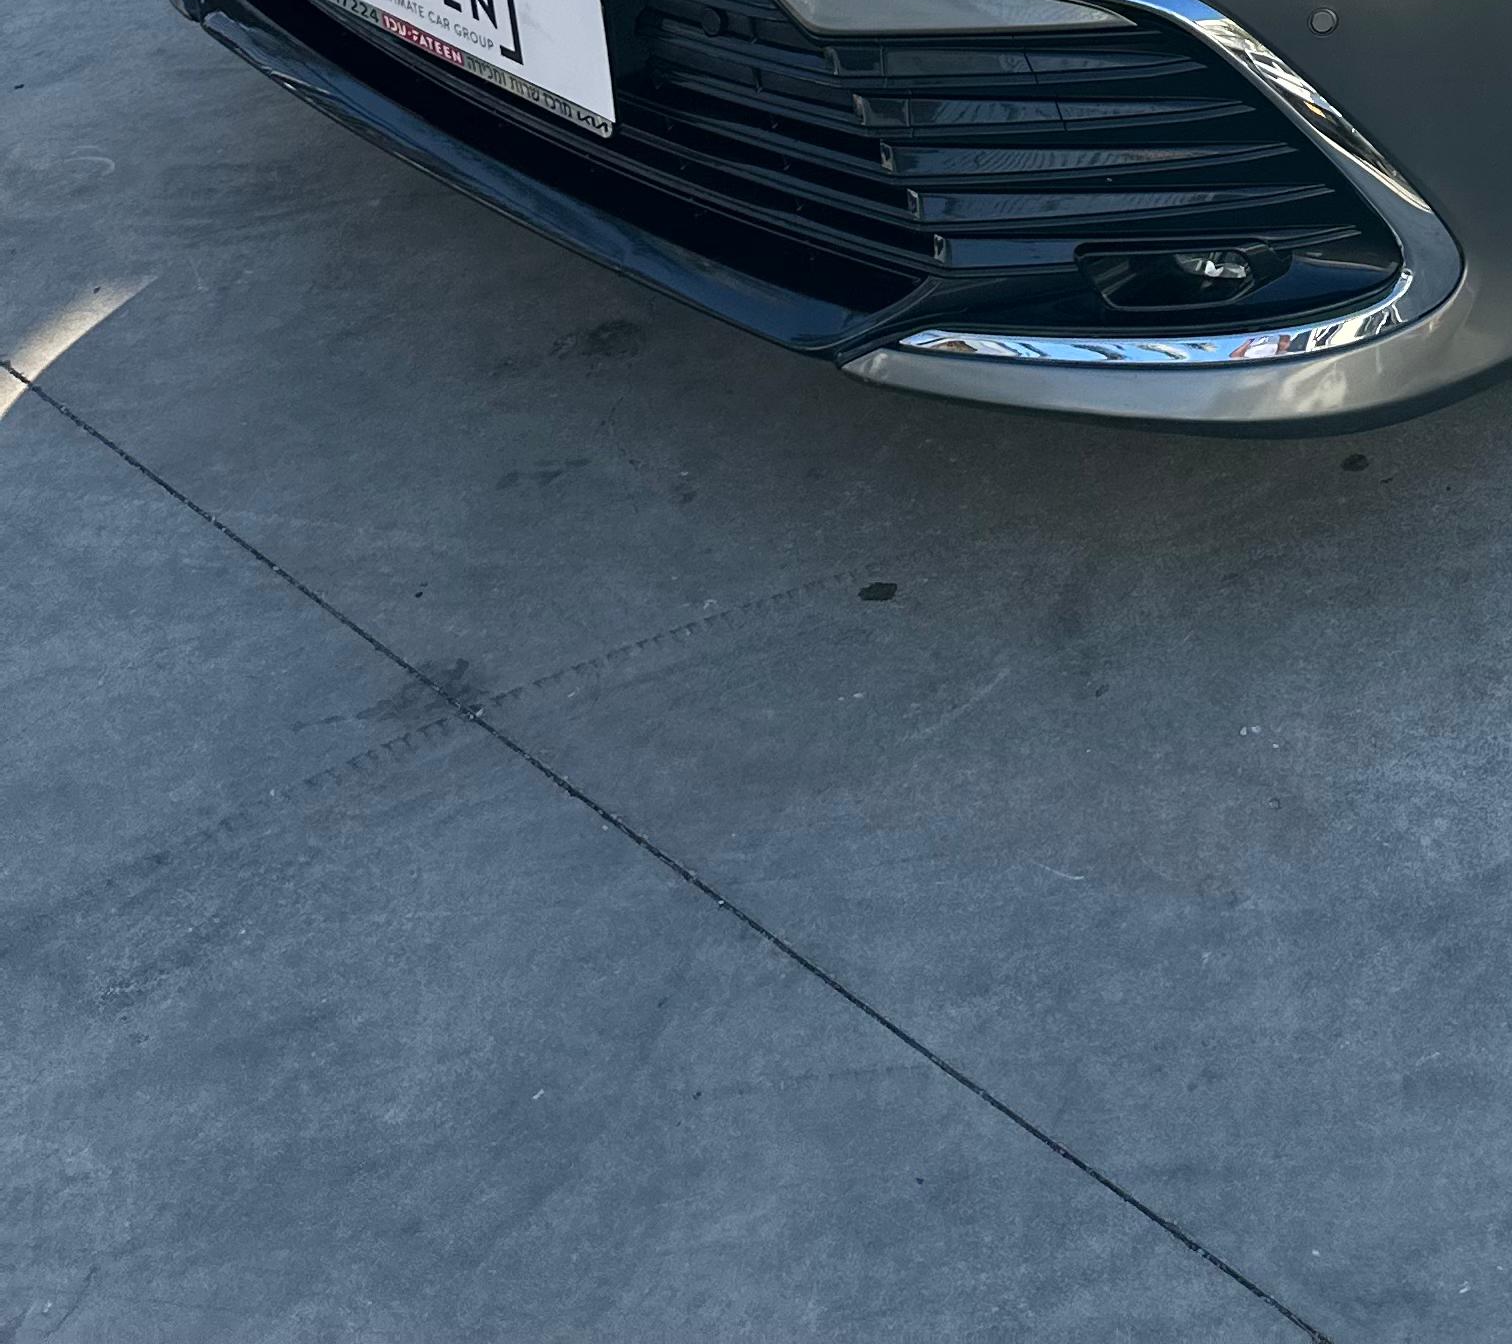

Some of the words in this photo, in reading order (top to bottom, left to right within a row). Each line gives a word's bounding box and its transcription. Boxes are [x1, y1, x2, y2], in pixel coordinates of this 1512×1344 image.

[411, 31, 463, 64] FATEEN
[428, 11, 451, 31] CAR
[454, 23, 494, 51] GROUP
